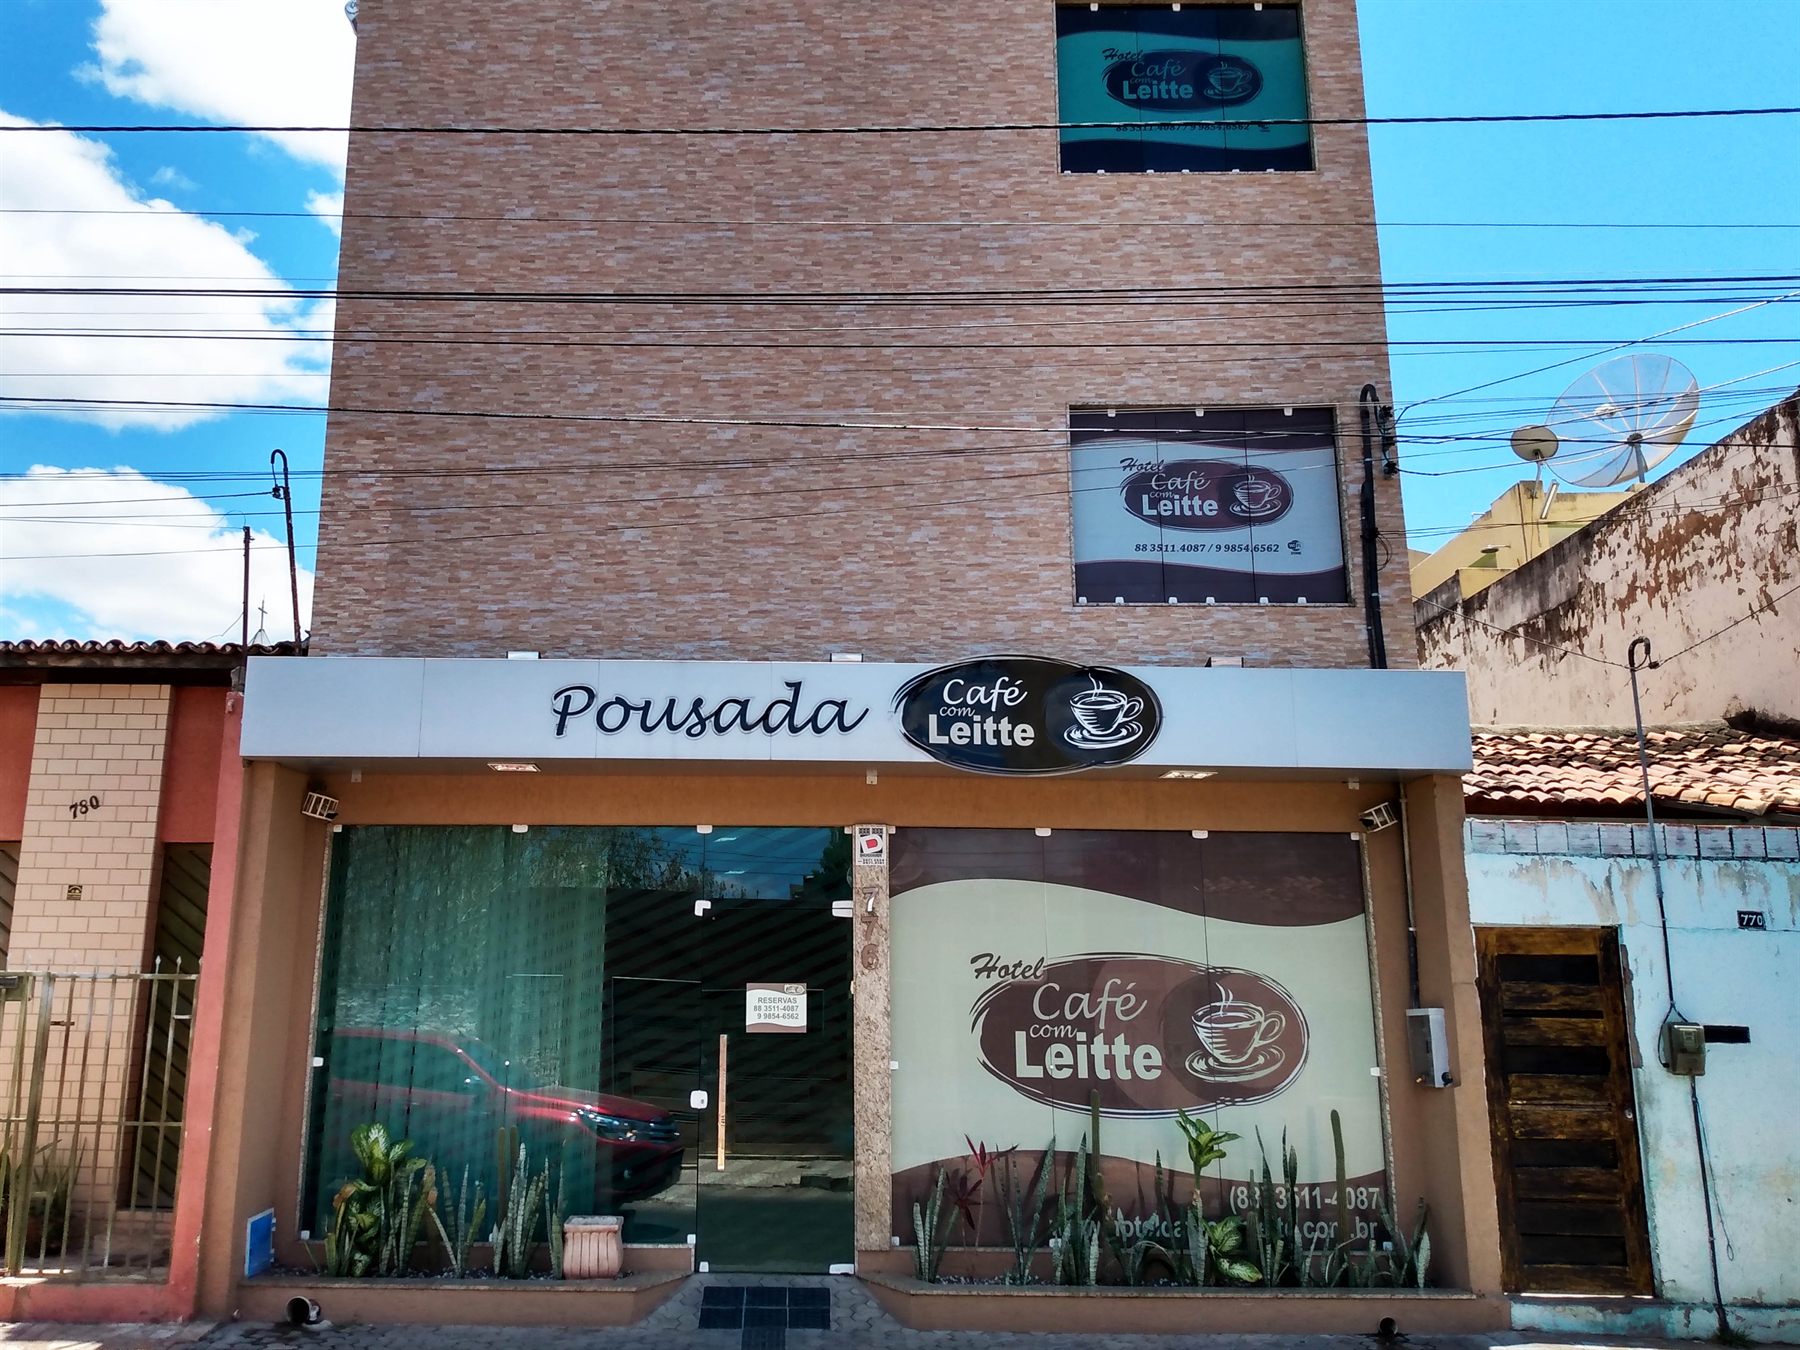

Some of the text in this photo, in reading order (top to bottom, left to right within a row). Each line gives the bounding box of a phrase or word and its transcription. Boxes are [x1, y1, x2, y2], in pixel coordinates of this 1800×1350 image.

[1102, 47, 1144, 62] Hotel
[1131, 59, 1186, 79] Café
[1122, 80, 1194, 100] Leitte
[1119, 457, 1165, 473] Hotel
[1151, 470, 1211, 494] Café
[1149, 490, 1176, 499] com
[1142, 494, 1219, 516] Leitte
[1134, 543, 1148, 553] 88
[942, 676, 1028, 712] Café
[551, 680, 870, 740] Pousada
[939, 705, 977, 717] com
[928, 713, 1035, 747] Leitte
[69, 795, 100, 819] 780
[1741, 914, 1763, 926] 770
[970, 953, 1045, 981] Hotel
[757, 996, 798, 1004] RESERVAS
[1032, 978, 1148, 1029] Café
[763, 1012, 799, 1020] 9854-6562
[1029, 1023, 1078, 1038] com
[1014, 1030, 1162, 1080] Leitte
